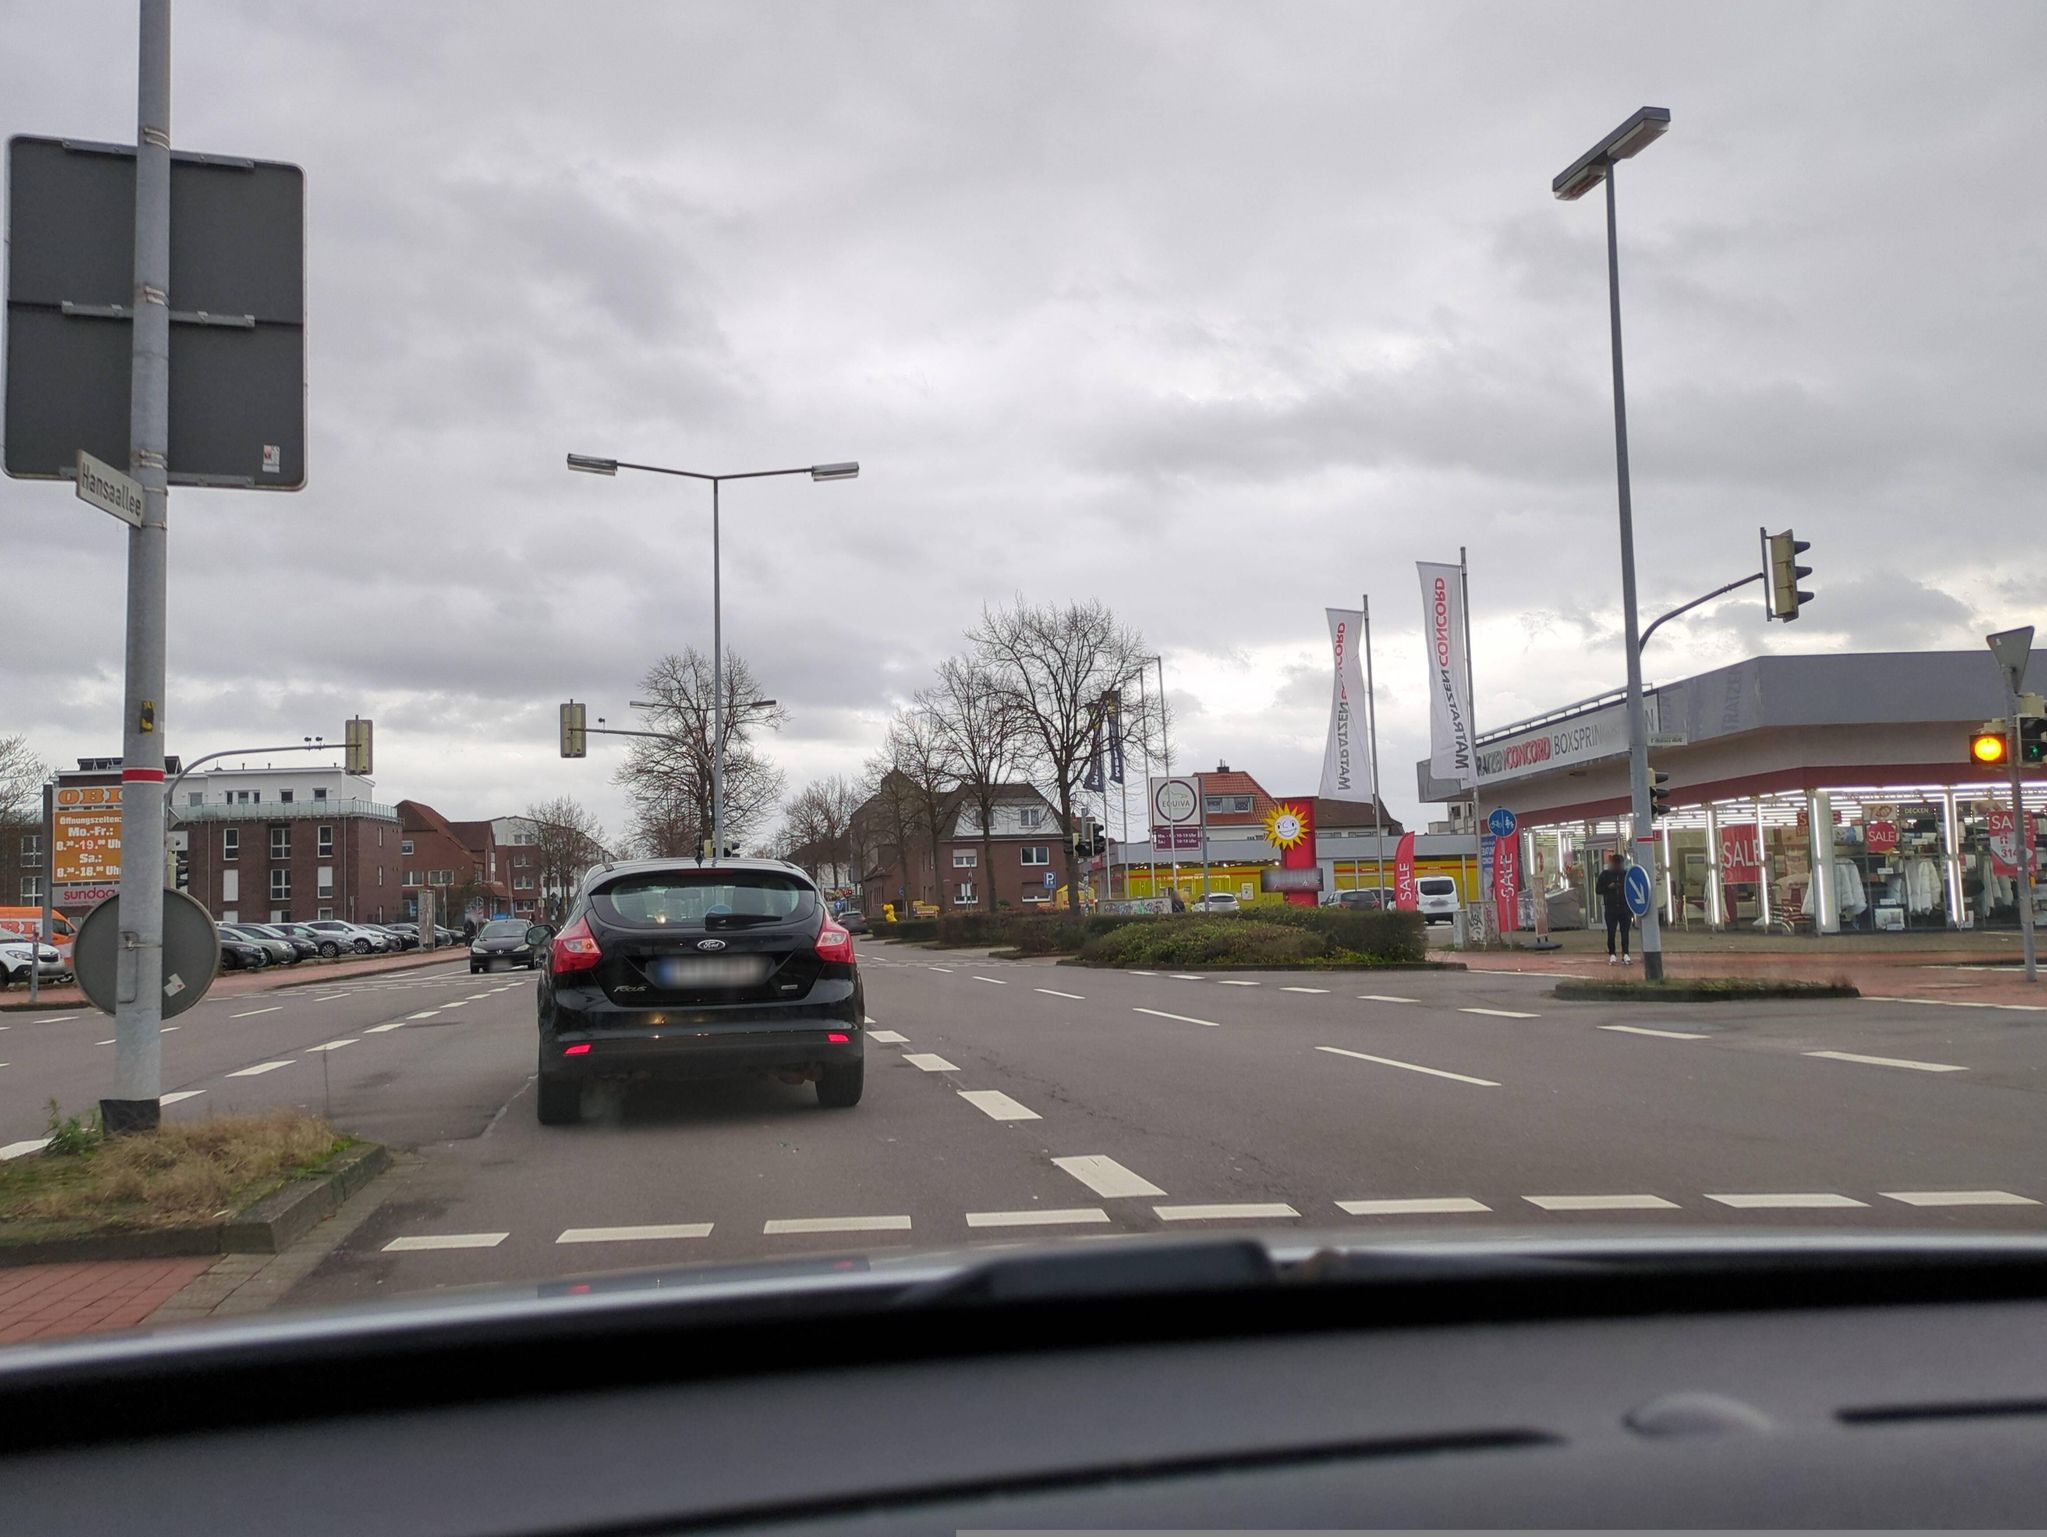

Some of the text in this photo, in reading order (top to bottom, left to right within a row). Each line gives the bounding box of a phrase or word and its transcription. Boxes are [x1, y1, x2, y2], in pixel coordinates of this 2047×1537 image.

[82, 462, 141, 517] Hansaallee
[1504, 736, 1551, 770] CONCORD
[58, 788, 122, 805] OBI
[1904, 807, 1929, 815] DECKEN
[1991, 814, 2031, 830] SAE
[68, 826, 114, 837] Mo.-Fr.:
[1868, 831, 1895, 842] SALE
[107, 839, 121, 849] Uh
[79, 853, 102, 863] Sa.:
[1723, 839, 1761, 868] SALE
[105, 866, 121, 876] Uh
[1500, 853, 1515, 898] SALE
[1046, 872, 1055, 886] P
[1399, 863, 1412, 901] SALE
